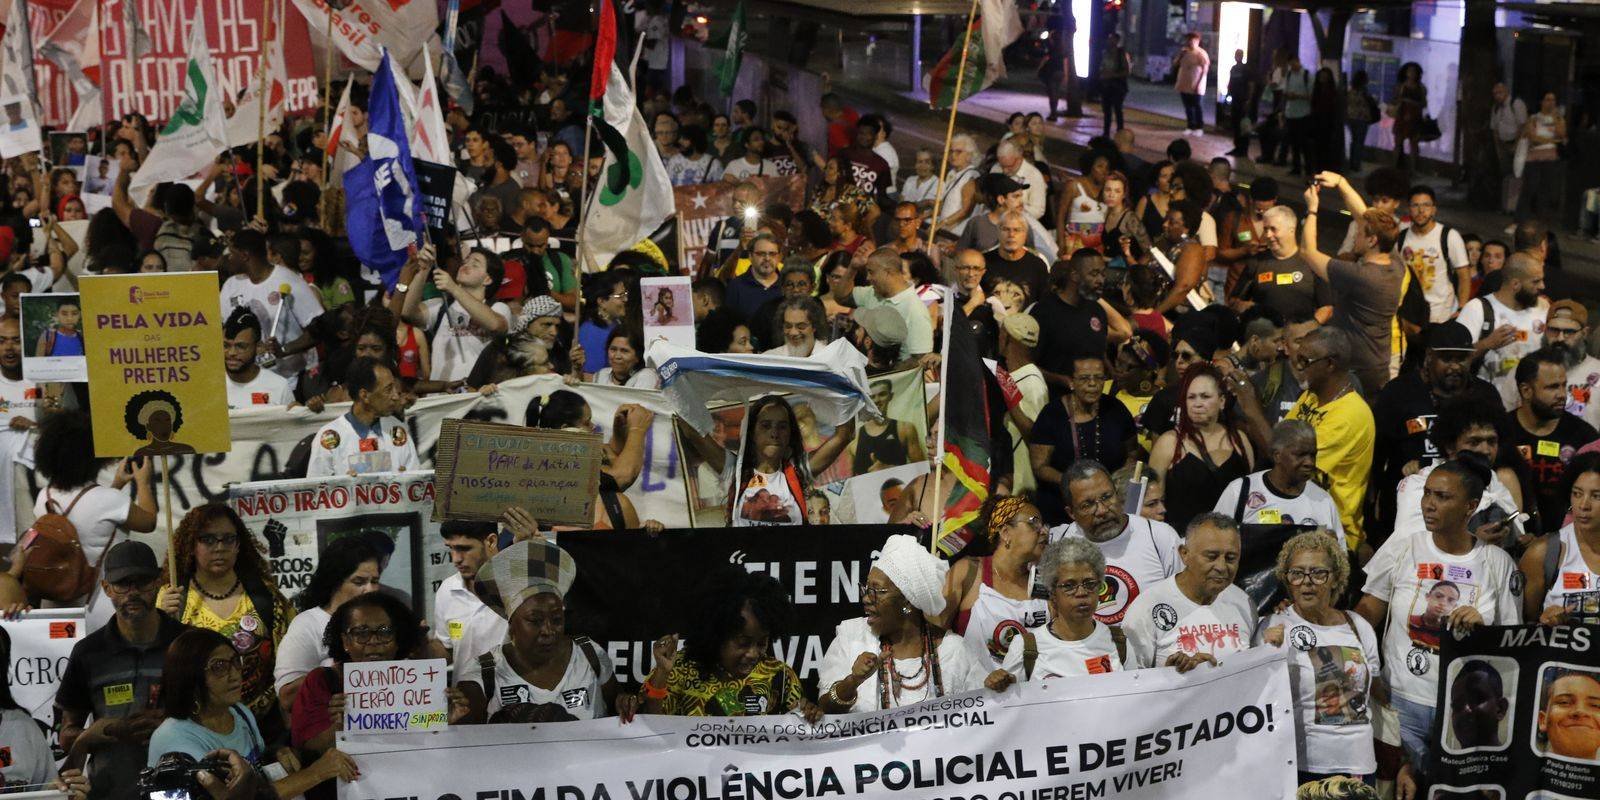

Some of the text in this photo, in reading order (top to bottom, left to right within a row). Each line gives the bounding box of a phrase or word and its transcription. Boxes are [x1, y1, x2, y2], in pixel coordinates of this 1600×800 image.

[97, 311, 209, 329] PELA VIDA
[144, 334, 161, 342] DAS
[109, 345, 202, 365] MULHERES
[124, 366, 191, 385] PRETAS
[237, 481, 436, 518] NÃO IRÃO NOS CA
[272, 557, 313, 574] RCOS
[1178, 622, 1240, 635] MARIELLE
[1500, 623, 1592, 652] MÃES
[8, 656, 72, 687] GRO
[348, 665, 418, 688] QUANTOS
[347, 688, 432, 709] TERÃO QUE
[347, 712, 410, 731] MORRER?
[690, 723, 768, 735] JORNADA
[773, 724, 807, 736] DOS
[919, 695, 985, 713] NEGROS
[686, 733, 770, 748] CONTRA
[904, 711, 995, 730] POLICIAL
[625, 763, 845, 800] VIOLÊNCIA
[854, 749, 1037, 794] POLICIAL
[1046, 745, 1069, 776] E
[1079, 738, 1127, 773] DE
[1134, 703, 1275, 762] ESTADO!
[1112, 759, 1183, 793] VIVER!
